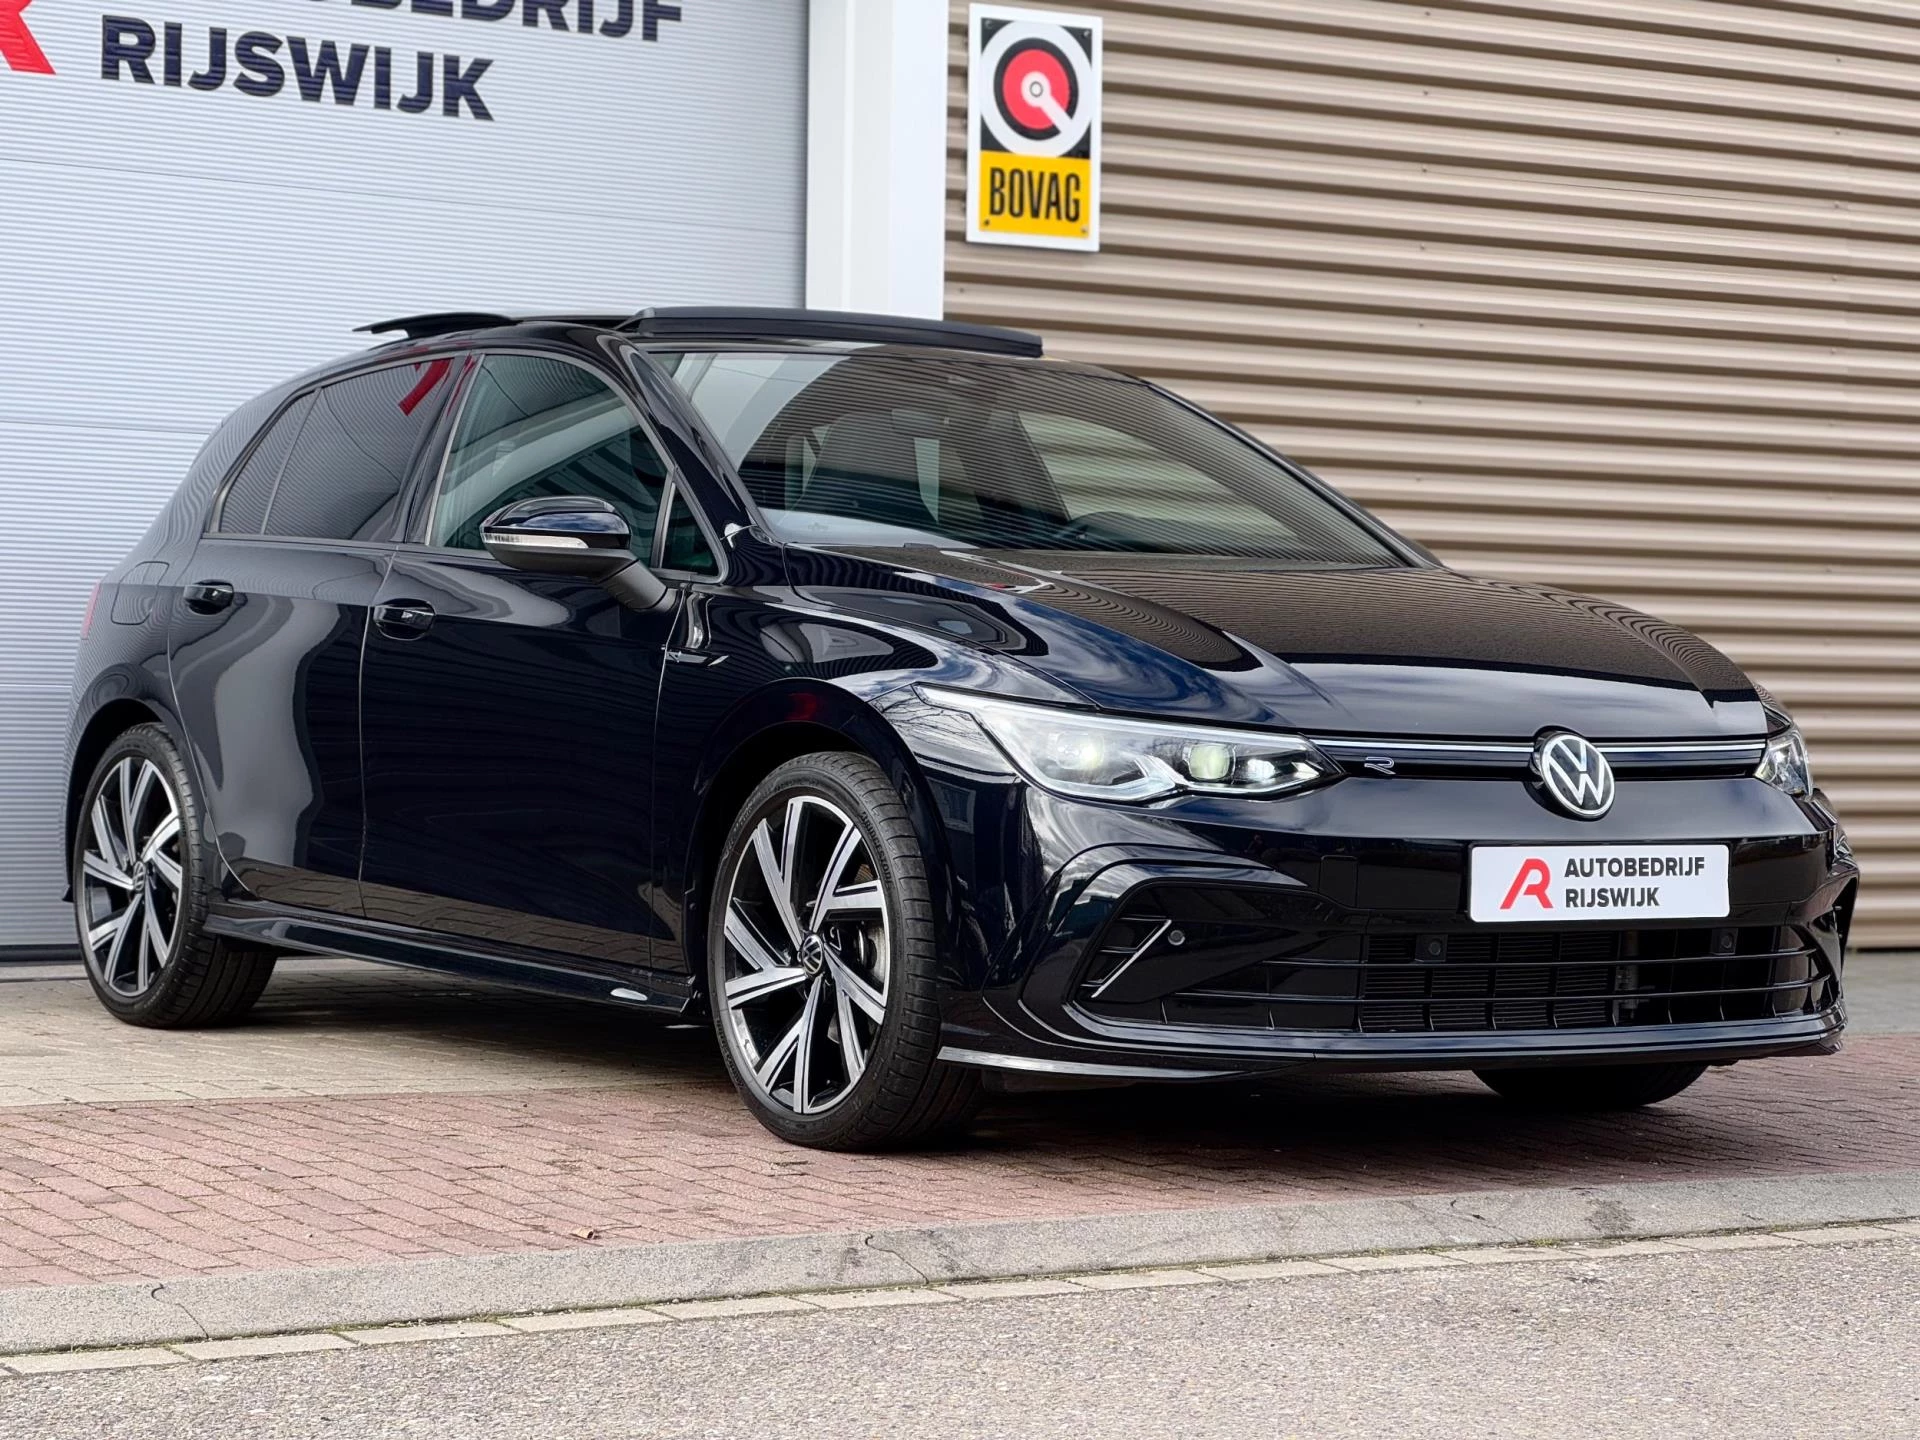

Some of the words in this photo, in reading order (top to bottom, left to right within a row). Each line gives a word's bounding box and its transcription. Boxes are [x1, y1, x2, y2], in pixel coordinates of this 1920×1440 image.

[101, 14, 494, 122] RIJSWIJK
[989, 168, 1080, 223] BOVAG
[1564, 857, 1705, 878] AUTOBEDRIJF
[1565, 887, 1660, 908] RIJSWIJK
